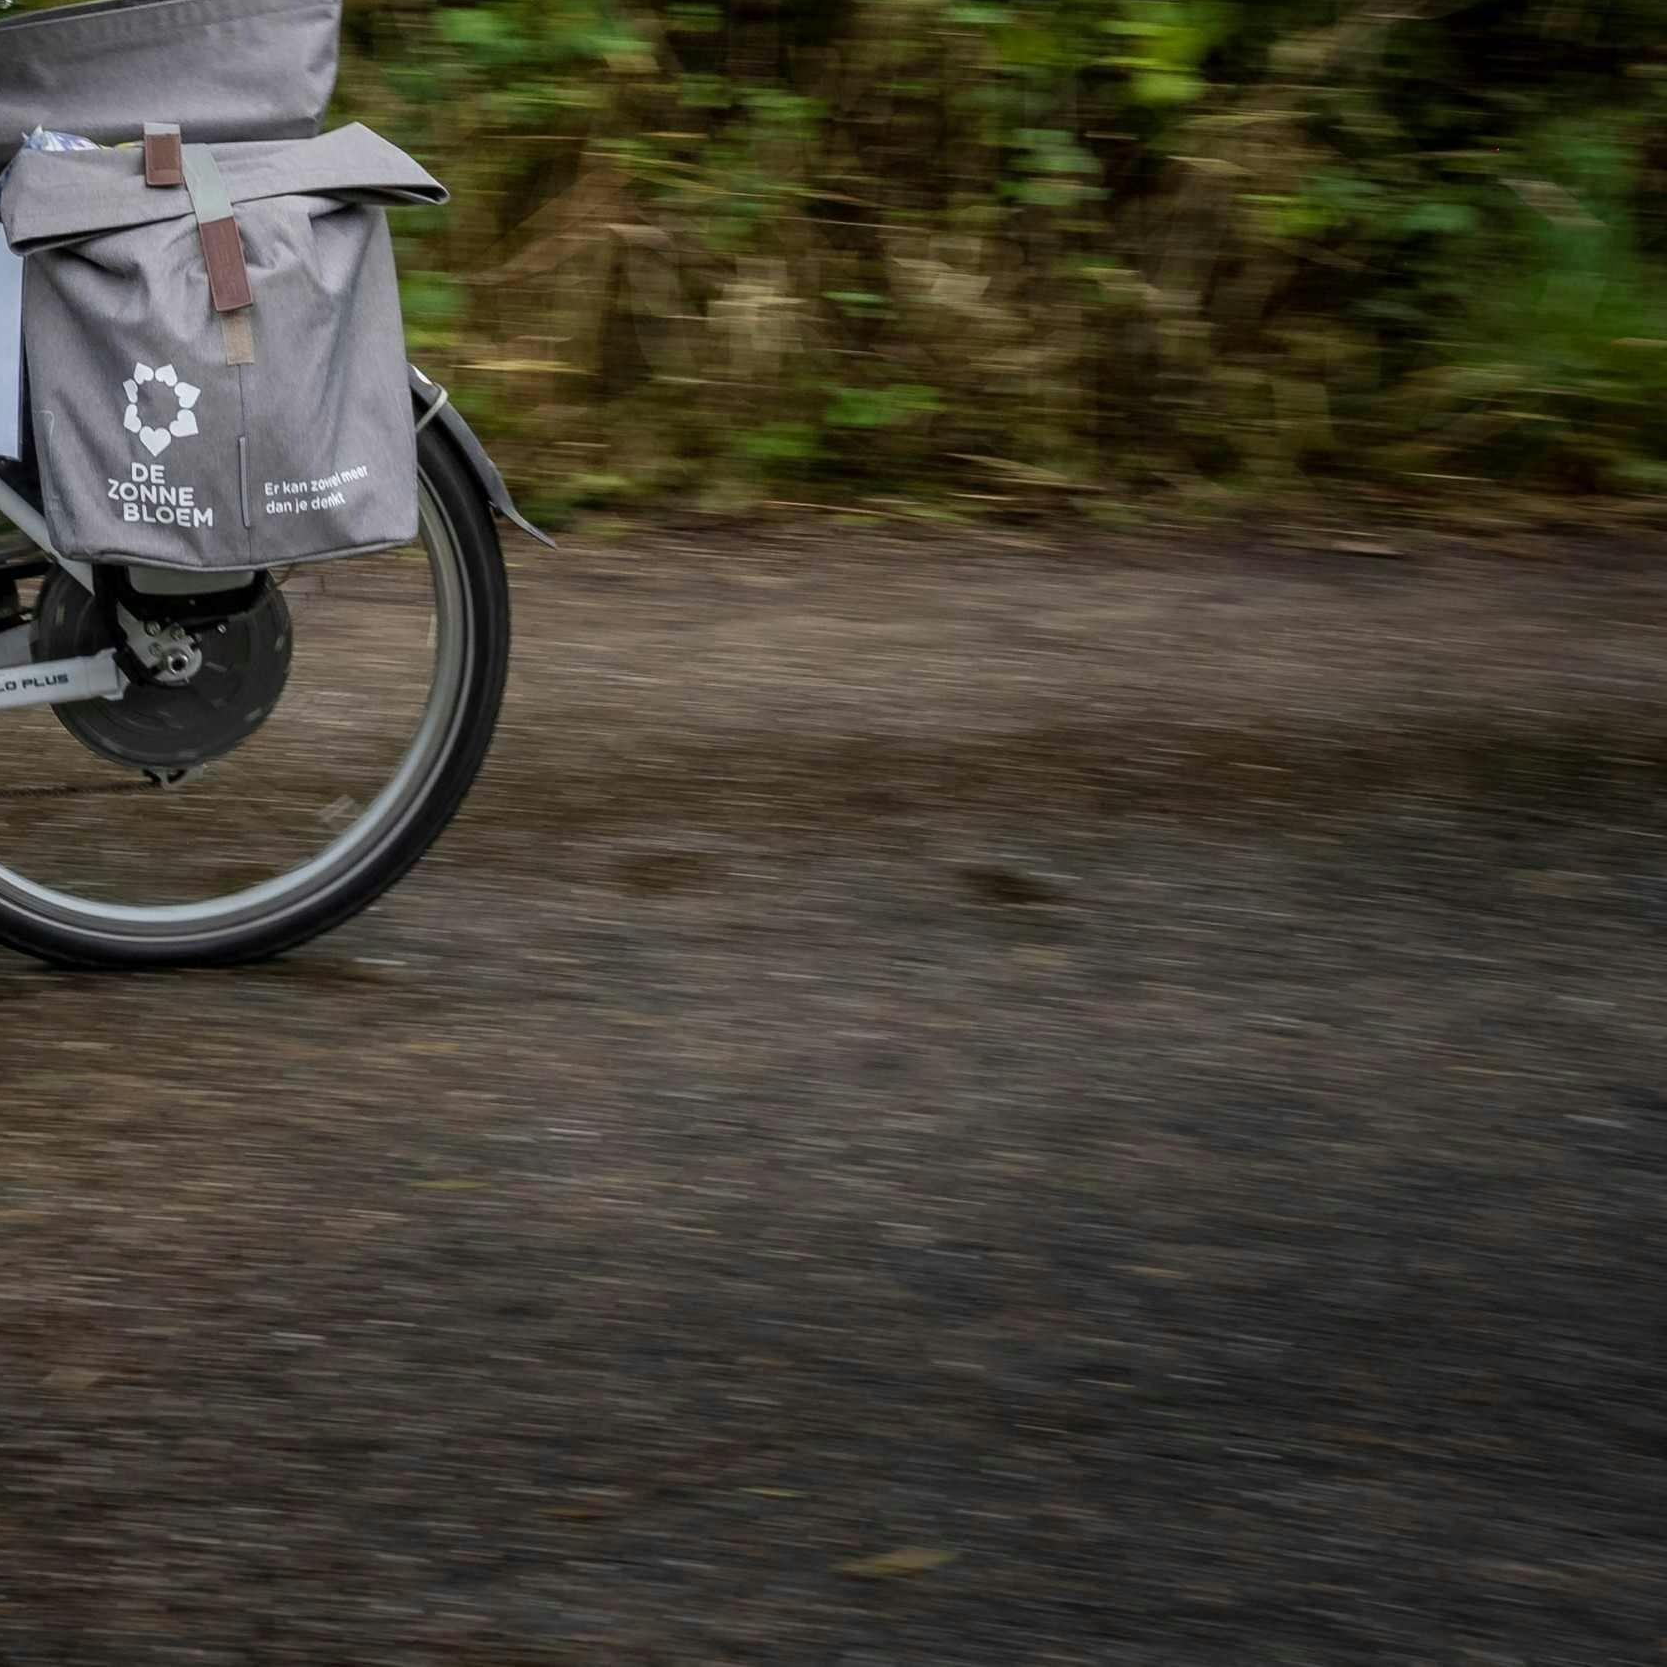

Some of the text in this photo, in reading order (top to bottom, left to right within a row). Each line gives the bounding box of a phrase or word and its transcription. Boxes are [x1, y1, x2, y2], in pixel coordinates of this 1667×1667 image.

[131, 462, 166, 484] DE
[107, 478, 195, 507] ZONNE
[264, 483, 280, 497] Er
[283, 480, 308, 495] kan
[122, 502, 214, 528] BLOEM
[266, 500, 293, 515] dan
[294, 498, 308, 514] je
[22, 673, 69, 689] PLUS
